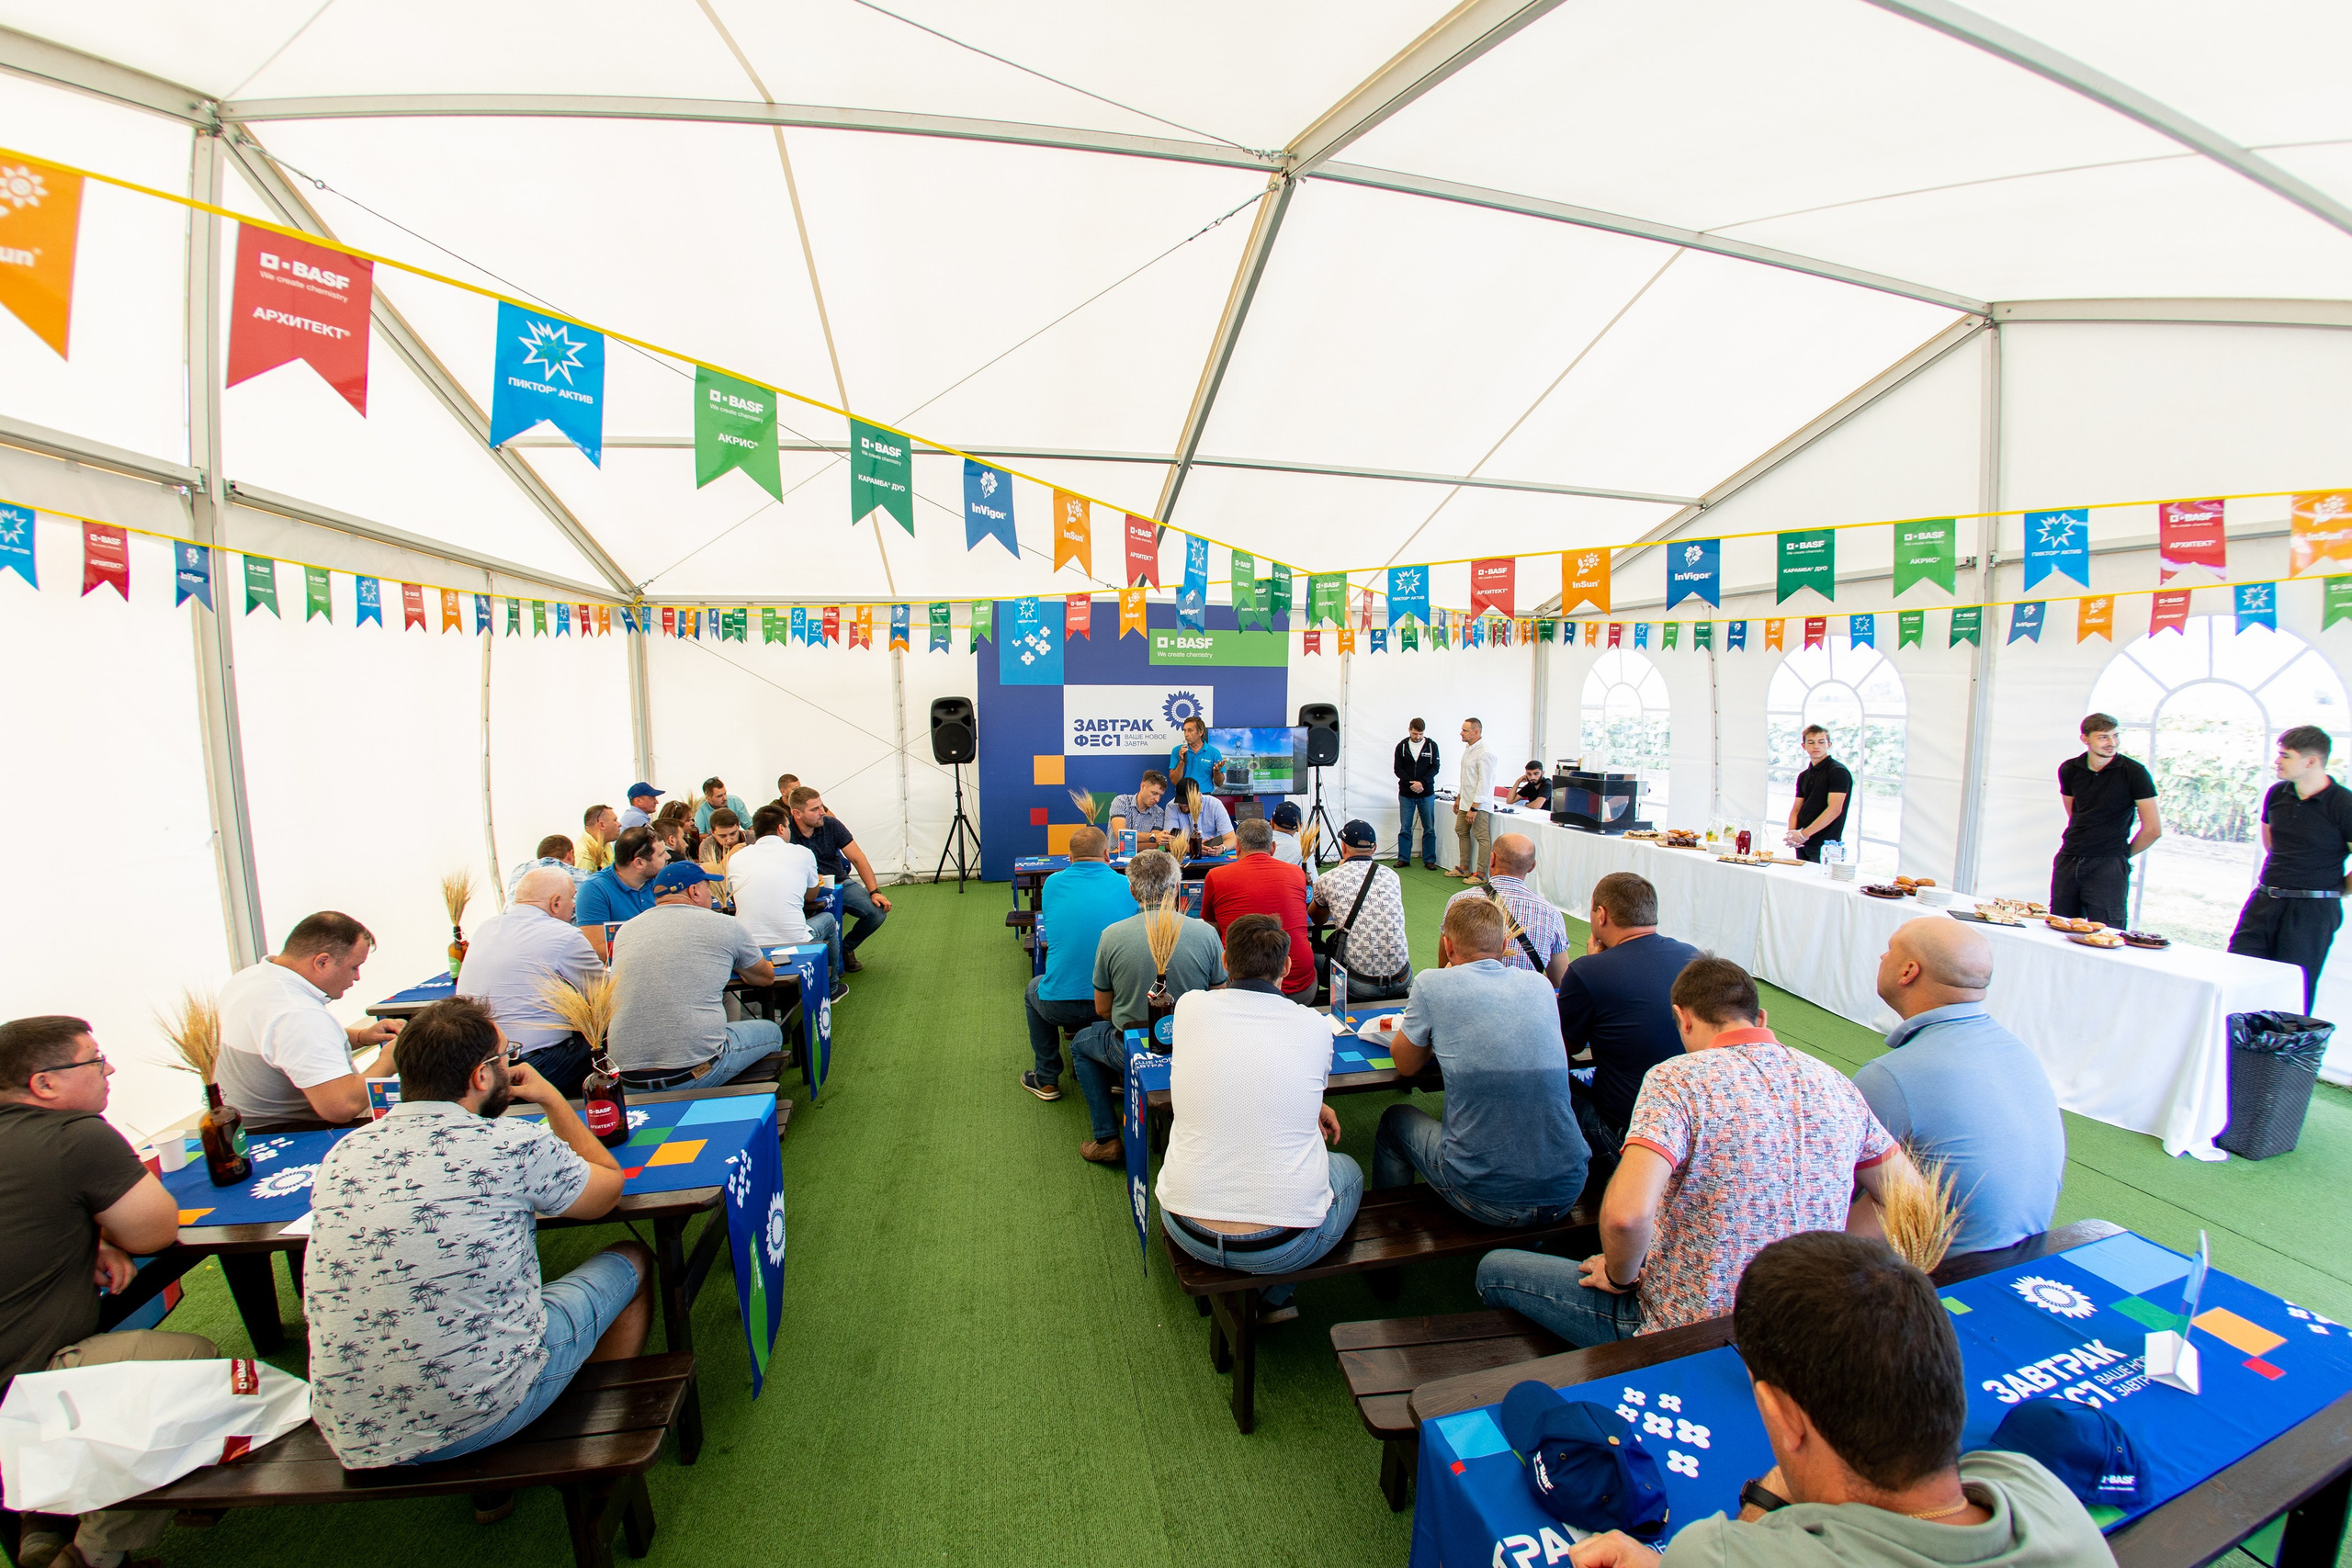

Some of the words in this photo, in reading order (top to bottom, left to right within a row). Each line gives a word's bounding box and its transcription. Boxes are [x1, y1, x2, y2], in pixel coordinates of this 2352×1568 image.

[292, 261, 350, 289] BASF
[259, 270, 275, 281] We
[277, 276, 305, 288] create
[306, 285, 348, 303] chemistry
[558, 389, 594, 404] АКТИВ
[729, 394, 763, 413] BASF
[719, 407, 737, 416] create
[738, 412, 763, 423] chemistry
[875, 442, 902, 457] BASF
[891, 483, 905, 491] ДУО
[2185, 512, 2212, 523] BASF
[1064, 529, 1084, 543] InSun
[1138, 529, 1152, 538] BASF
[1918, 531, 1945, 540] BASF
[1800, 540, 1826, 549] BASF
[1487, 567, 1508, 576] BASF
[1572, 580, 1600, 589] InSun
[1177, 637, 1213, 649] BASF
[1073, 718, 1154, 732] ЗАВТРАК
[1074, 734, 1121, 747] ФЕСТ
[595, 1106, 612, 1114] BASF
[1982, 1338, 2129, 1404] ЗАВТРАК
[2094, 1364, 2131, 1385] ВАШЕ
[2111, 1373, 2153, 1397] ЗАВТР
[1539, 1463, 1555, 1490] BASF
[2109, 1474, 2136, 1485] BASF
